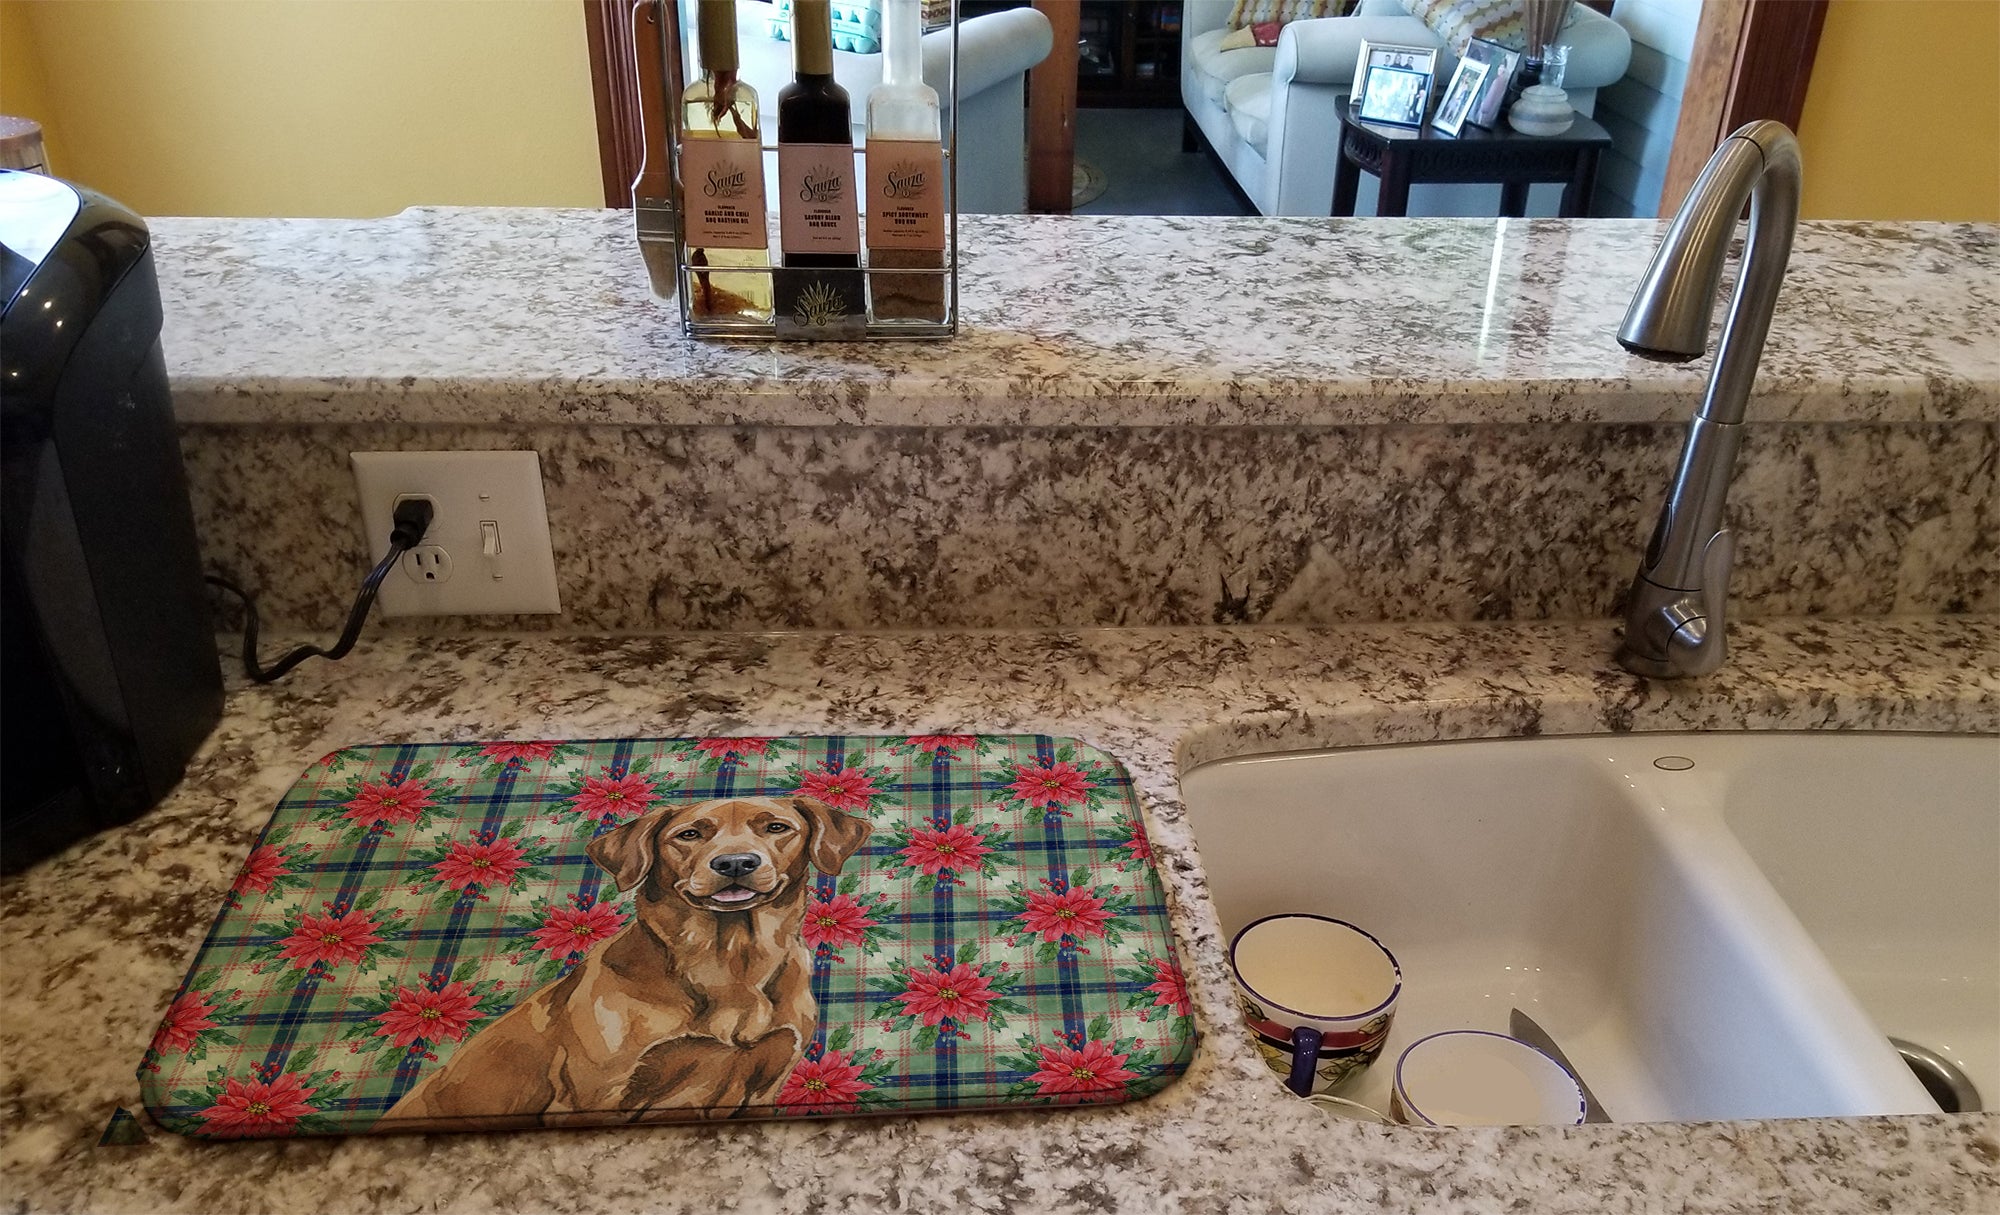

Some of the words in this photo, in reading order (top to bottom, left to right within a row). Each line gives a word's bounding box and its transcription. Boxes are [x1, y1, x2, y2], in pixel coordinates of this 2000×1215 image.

[703, 170, 745, 197] Sauza
[800, 175, 842, 202] Sauza
[883, 170, 925, 198] Sauza
